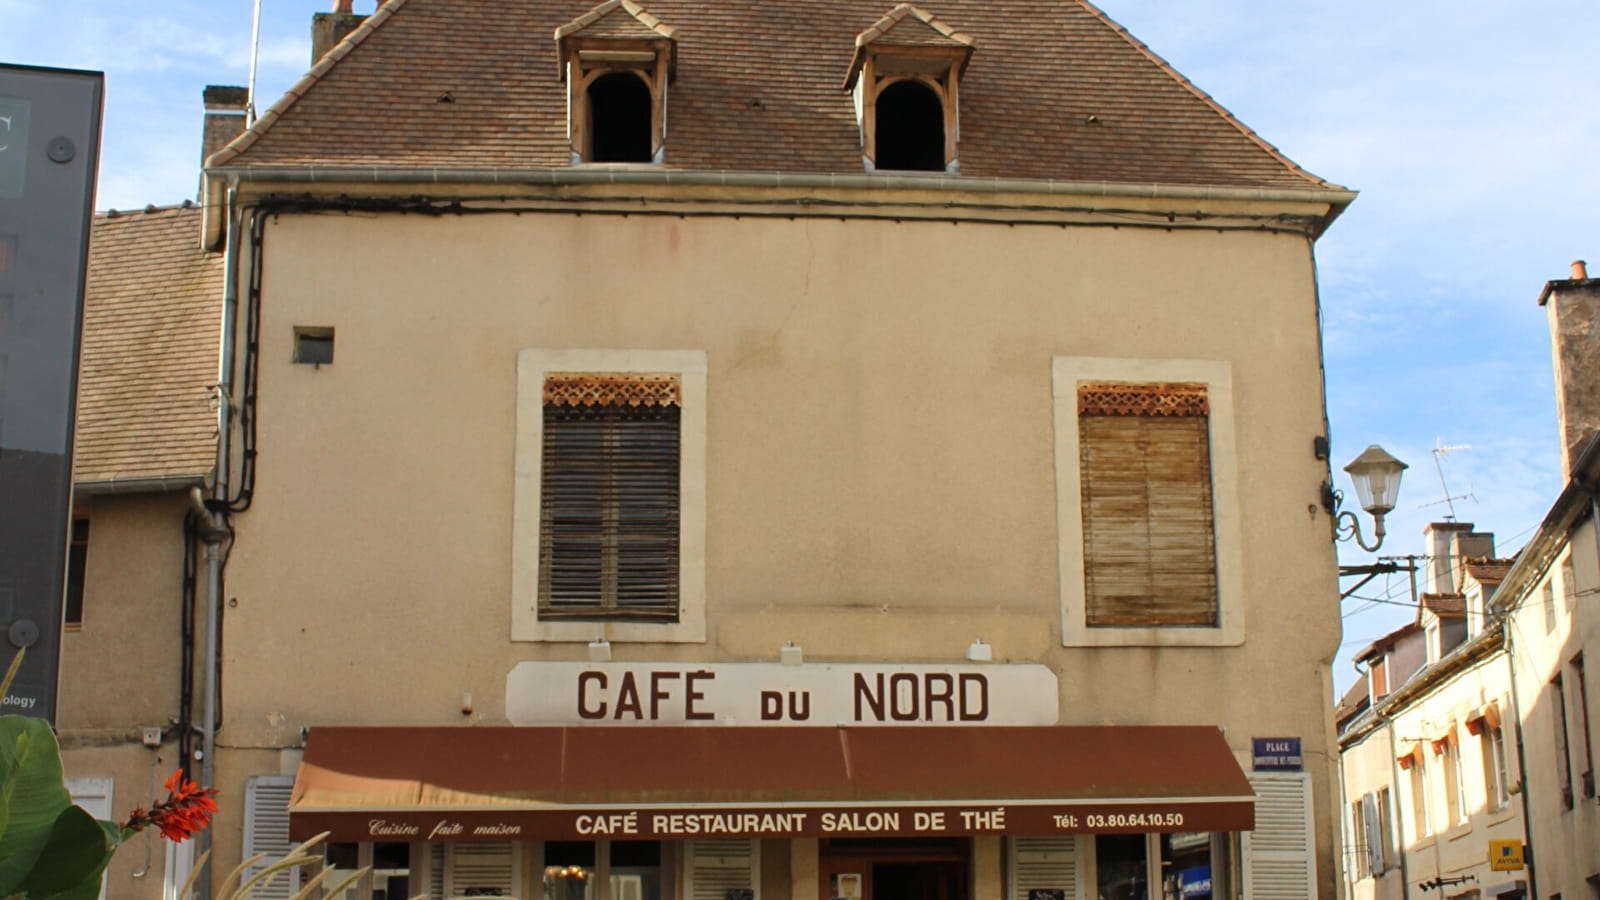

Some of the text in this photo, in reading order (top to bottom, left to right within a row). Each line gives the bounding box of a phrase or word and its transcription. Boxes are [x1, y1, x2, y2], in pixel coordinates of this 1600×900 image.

[578, 669, 989, 722] CAFÉ DU NORD
[1265, 741, 1290, 752] PLACE
[366, 818, 522, 840] Cuisine faite maison
[576, 807, 1006, 834] CAFÉ RESTAURANT SALON DE THÉ
[1053, 813, 1184, 828] Tél: 03.80.64.10.50
